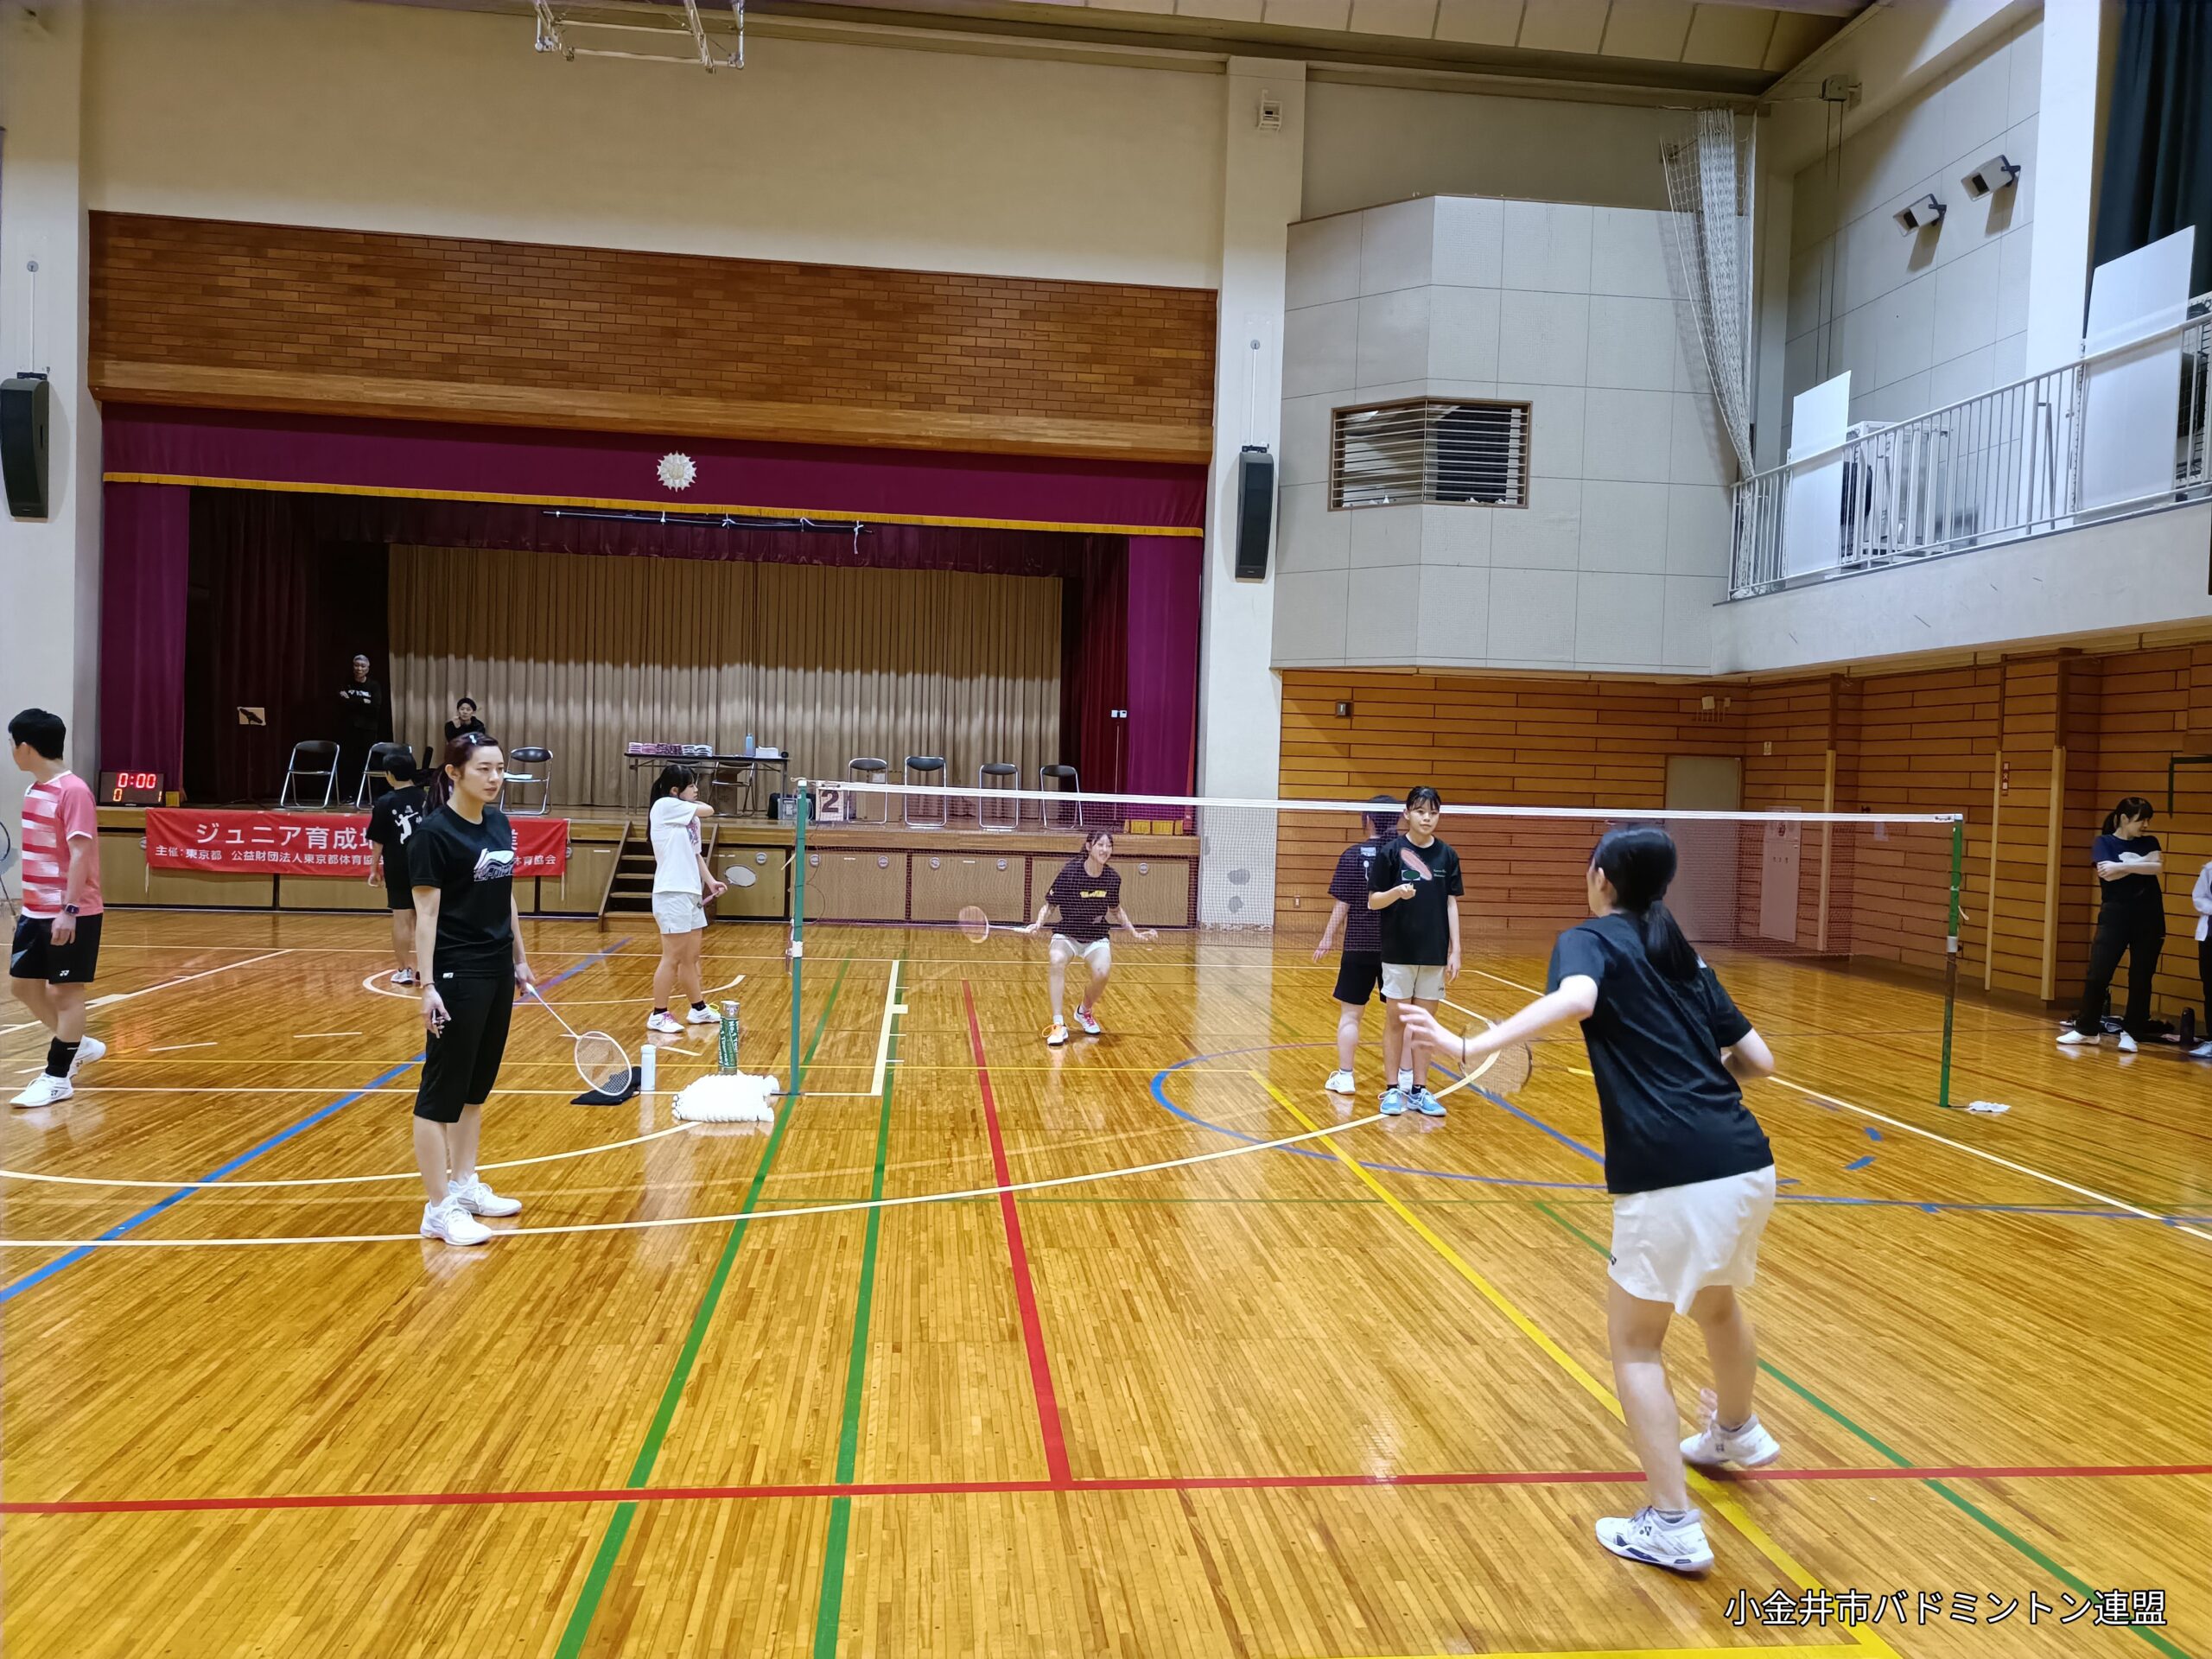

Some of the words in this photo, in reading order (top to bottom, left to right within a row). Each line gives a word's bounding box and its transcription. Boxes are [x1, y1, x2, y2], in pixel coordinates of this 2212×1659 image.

[118, 772, 156, 789] 0:00
[112, 788, 123, 802] 0
[821, 789, 839, 812] 2
